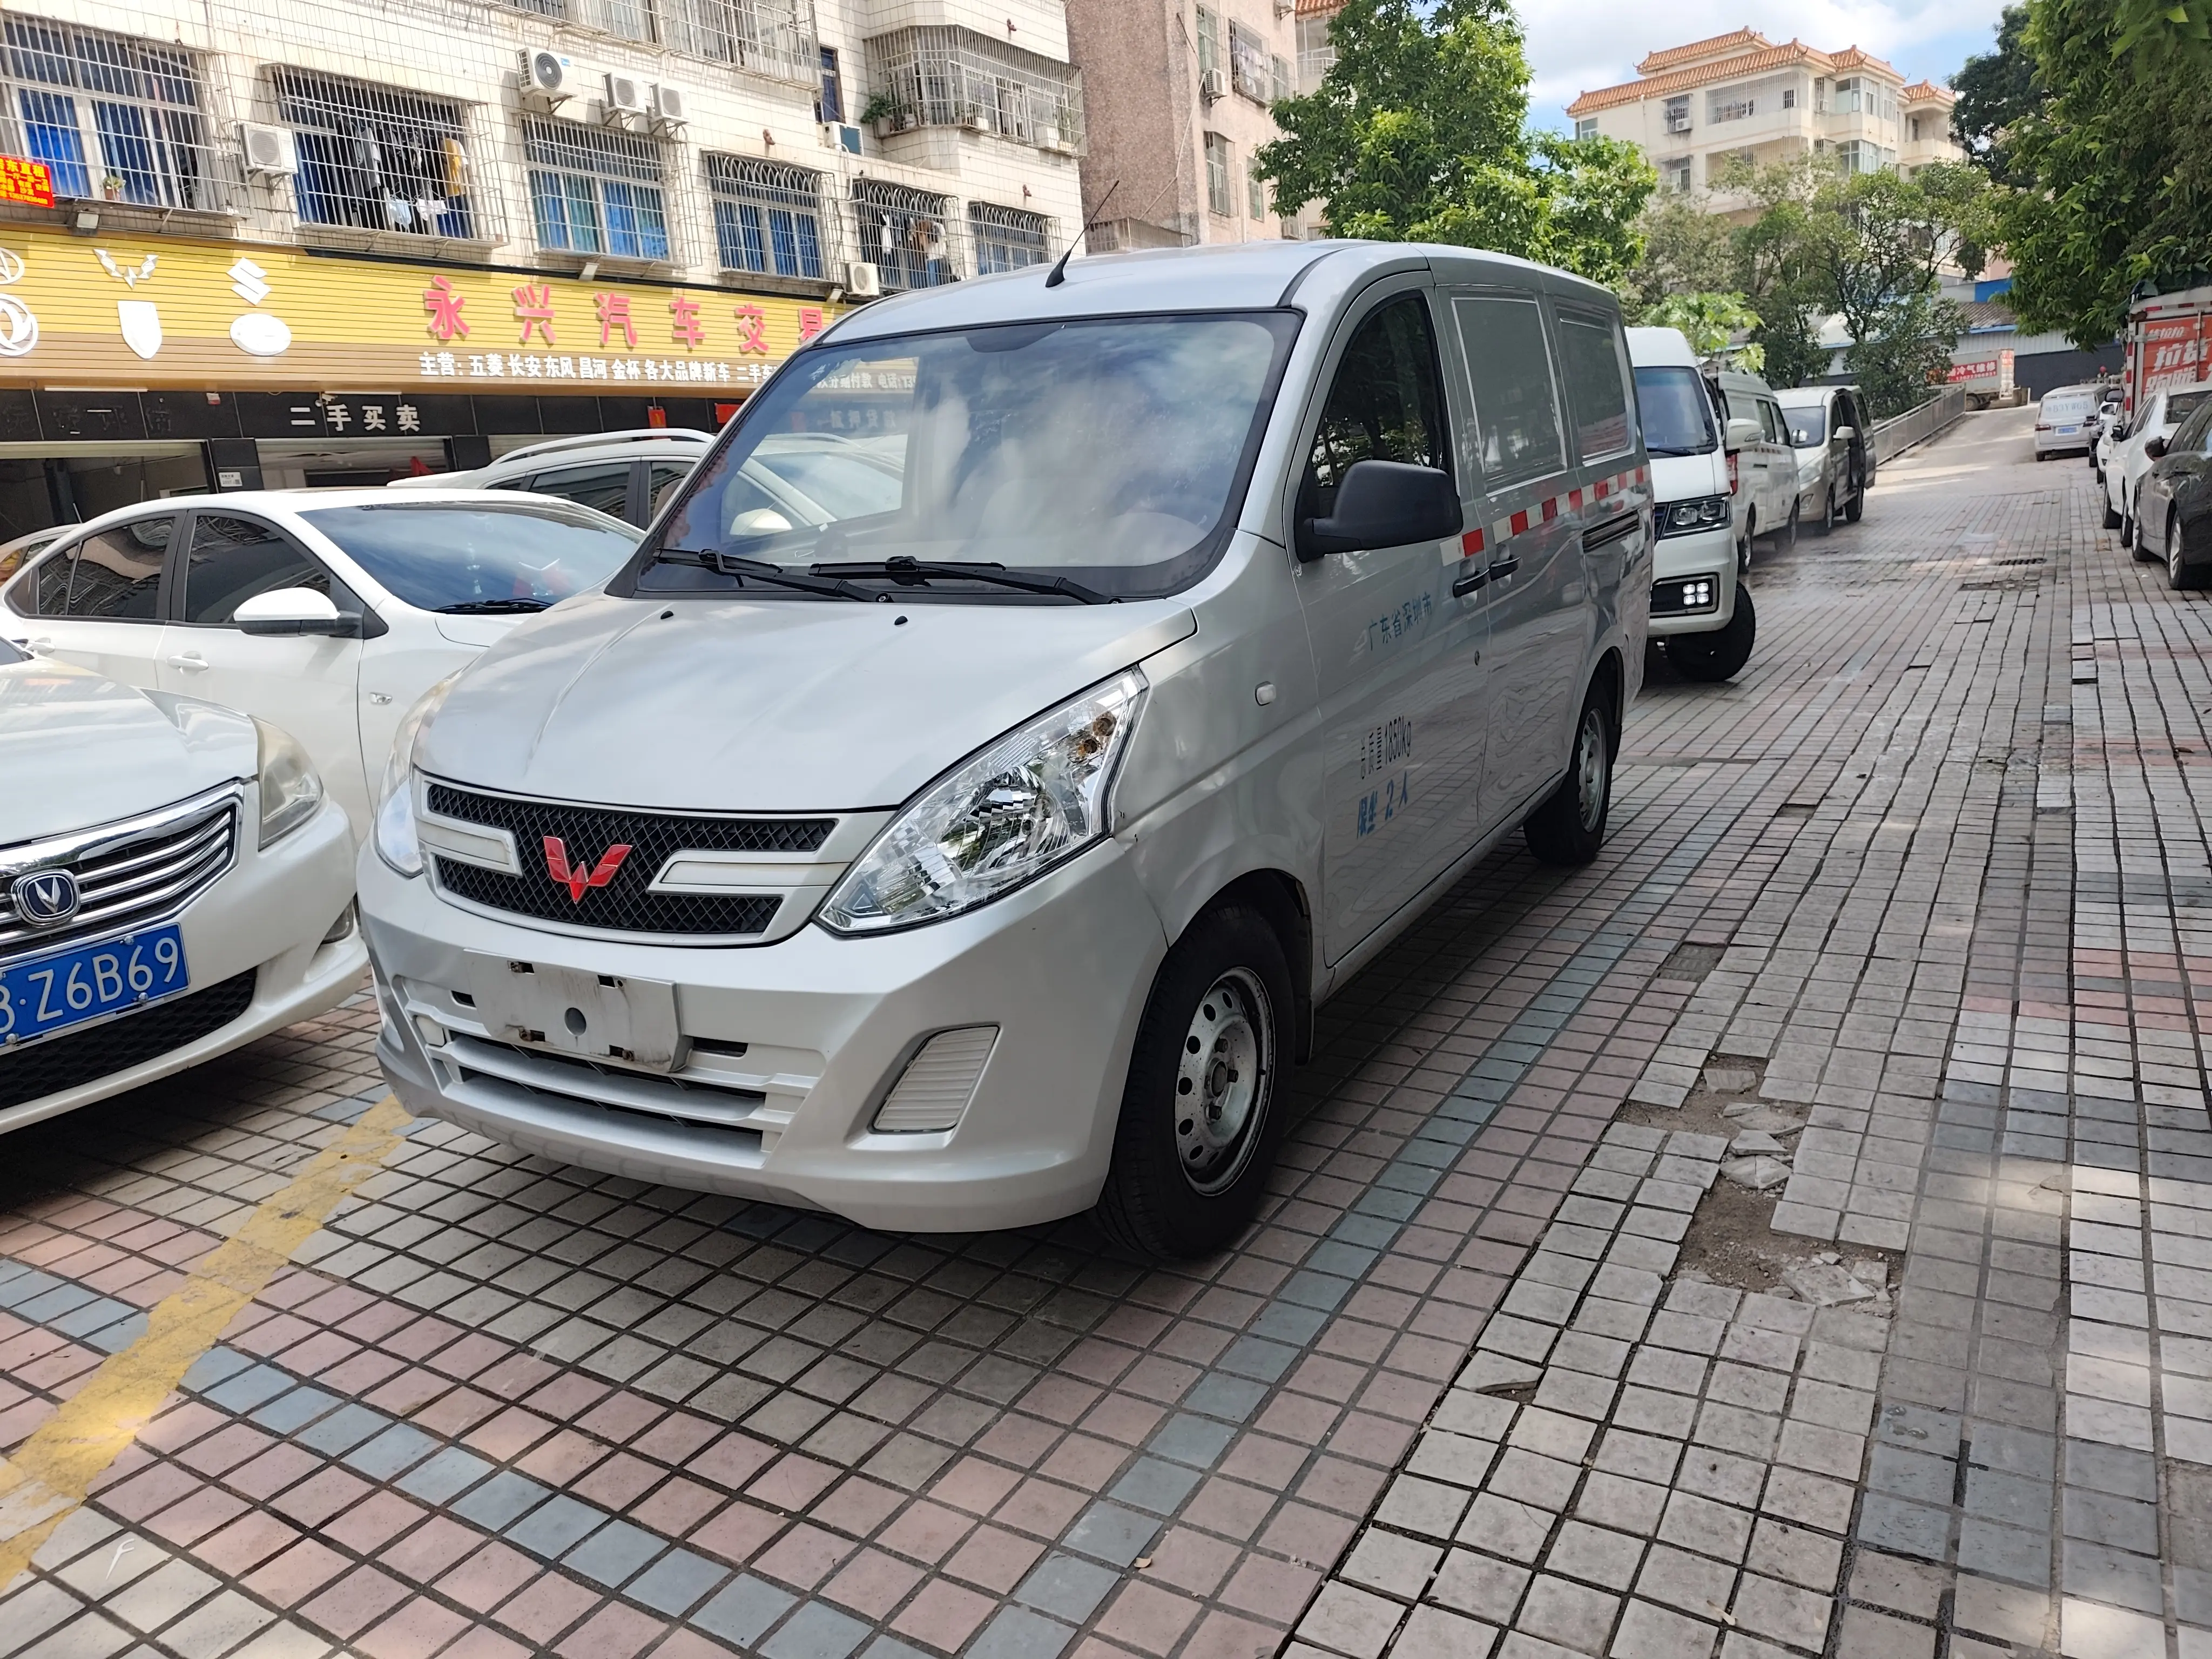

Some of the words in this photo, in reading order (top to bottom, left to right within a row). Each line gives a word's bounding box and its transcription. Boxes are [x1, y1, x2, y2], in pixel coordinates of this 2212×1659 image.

[423, 275, 823, 353] 永兴汽车交易
[737, 363, 779, 383] 二手车
[290, 404, 421, 433] 二手买卖
[1368, 590, 1432, 651] 广东省深圳市
